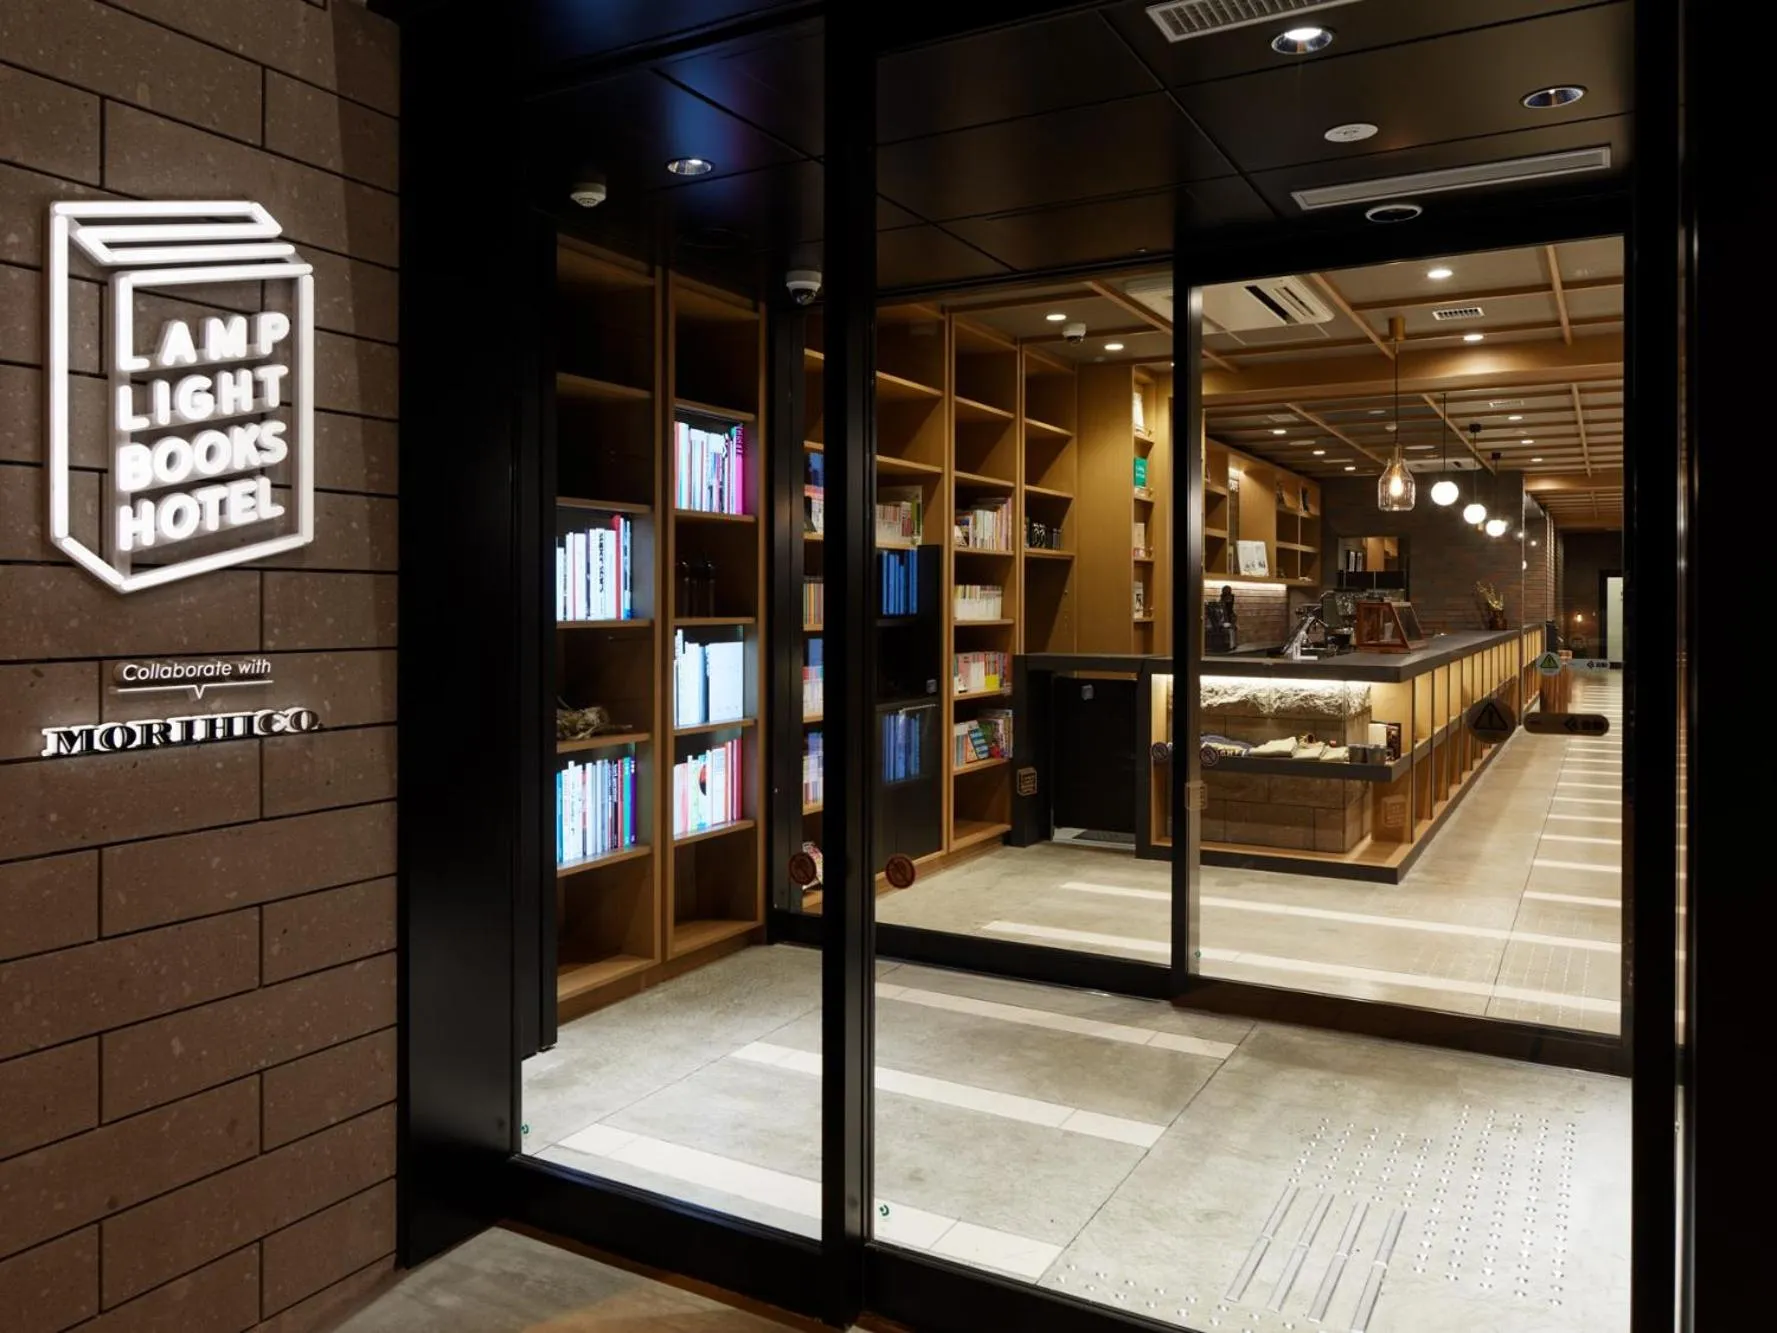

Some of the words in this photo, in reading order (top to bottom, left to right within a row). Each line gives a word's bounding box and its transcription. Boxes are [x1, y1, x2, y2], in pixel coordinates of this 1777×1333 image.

[117, 311, 290, 371] LAMP
[117, 364, 289, 431] LIGHT
[117, 419, 288, 491] BOOKS
[117, 475, 286, 551] HOTEL
[122, 662, 232, 682] Collaborate
[238, 659, 272, 675] with
